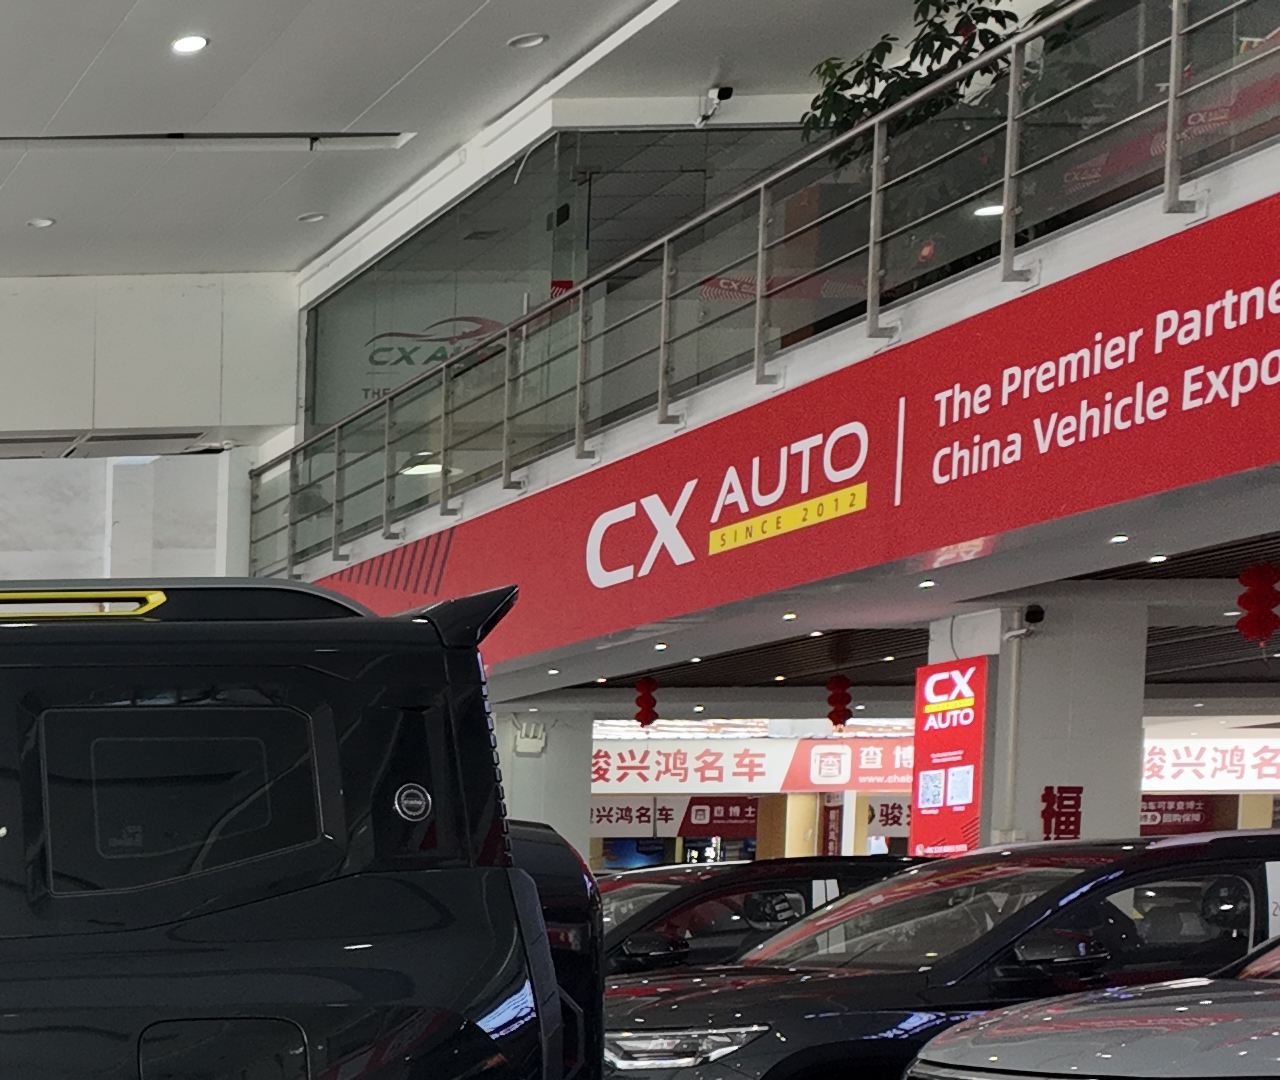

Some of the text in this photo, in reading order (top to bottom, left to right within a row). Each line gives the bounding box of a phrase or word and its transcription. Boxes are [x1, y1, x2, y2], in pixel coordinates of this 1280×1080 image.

[368, 346, 422, 366] CX
[933, 383, 991, 428] The
[1000, 328, 1144, 406] Premier
[931, 348, 1280, 485] China Vehicle Expo
[585, 421, 869, 589] CX AUTO
[720, 492, 857, 548] SINCE 2012
[924, 666, 976, 704] CX
[923, 708, 974, 731] AUTO
